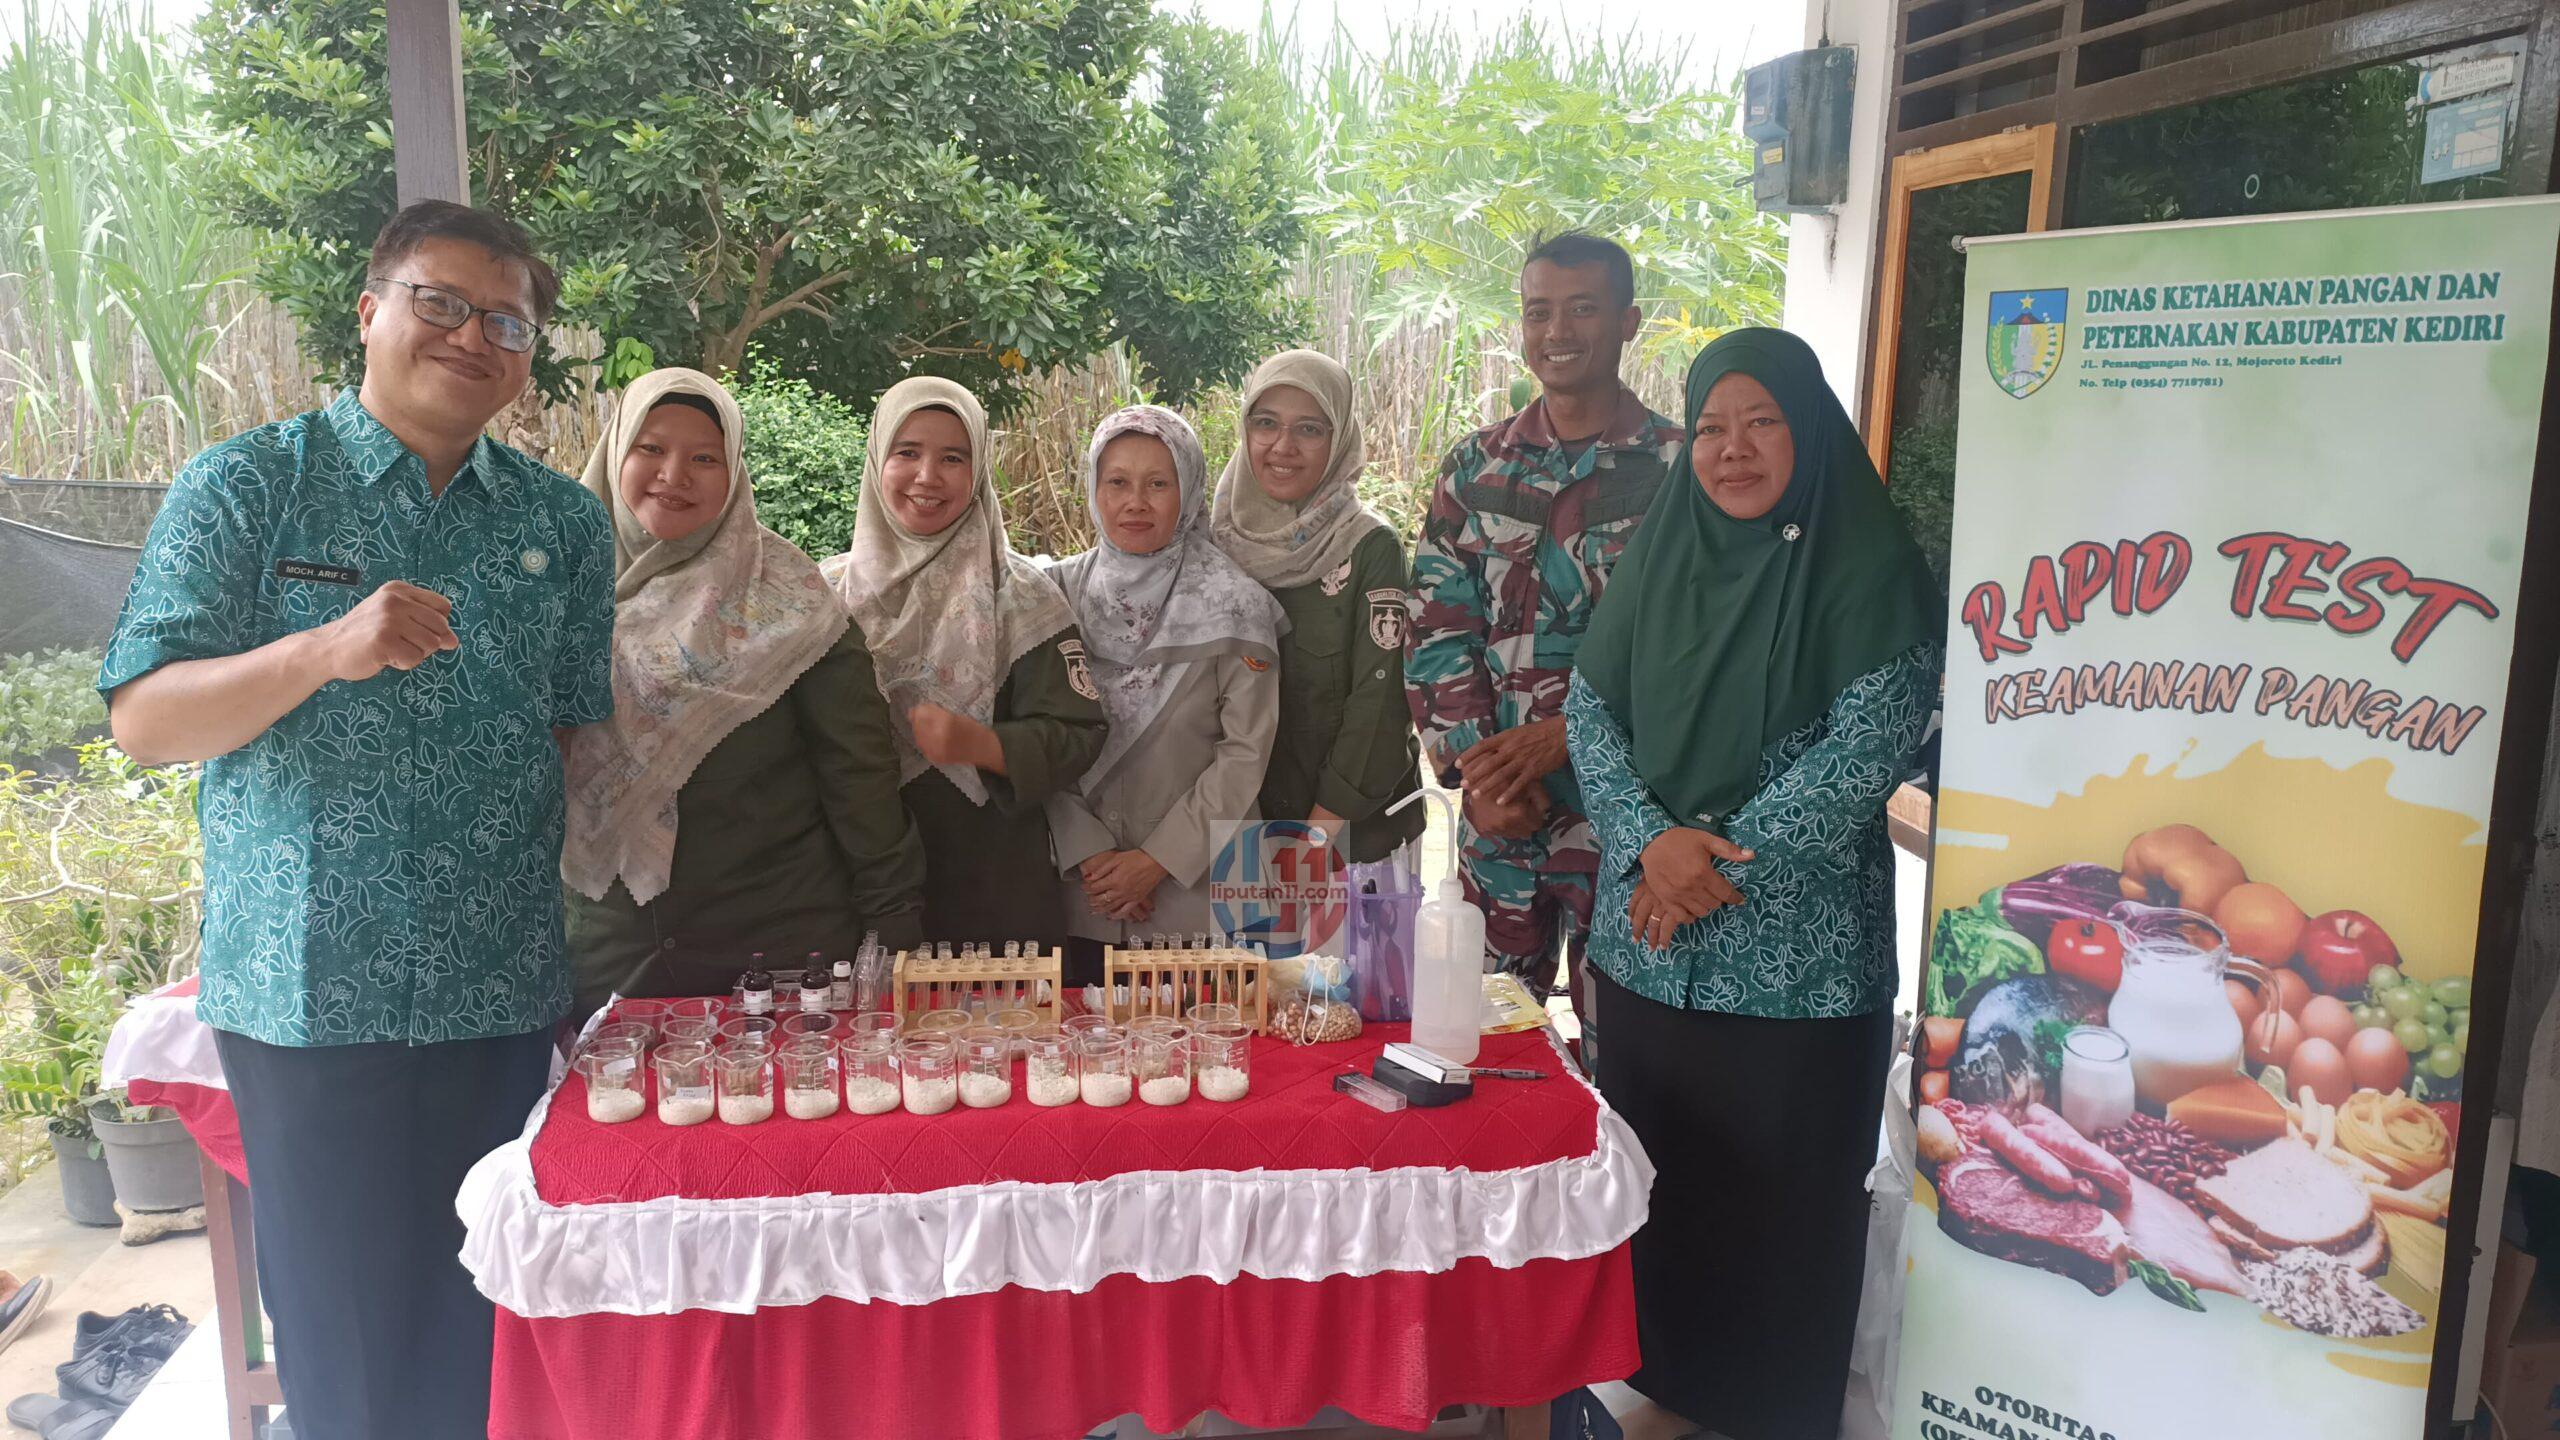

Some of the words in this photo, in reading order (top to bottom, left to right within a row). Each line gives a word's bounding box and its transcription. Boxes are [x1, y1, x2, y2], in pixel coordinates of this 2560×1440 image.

[2086, 285, 2157, 314] DINAS
[2162, 280, 2314, 311] KETAHANAN
[2318, 275, 2432, 305] PANGAN
[2437, 271, 2501, 300] DAN
[2082, 321, 2239, 350] PETERNAKAN
[2243, 317, 2398, 347] KABUPATEN
[2403, 314, 2506, 343] KEDIRI
[2080, 359, 2098, 369] JL.
[2102, 358, 2188, 370] Penanggungan
[2191, 357, 2211, 367] No.
[2236, 356, 2296, 369] Mojoroto
[2300, 355, 2342, 366] Kediri
[2079, 378, 2098, 388] No.
[2102, 378, 2127, 390] Telp
[2130, 377, 2168, 389] (0354)
[286, 566, 314, 576] MOCH
[318, 570, 339, 579] ARIF
[1962, 531, 2193, 662] RAPID
[2218, 531, 2500, 664] TEST
[1985, 660, 2253, 725] KEAMANAN
[2256, 666, 2488, 756] PANGAN
